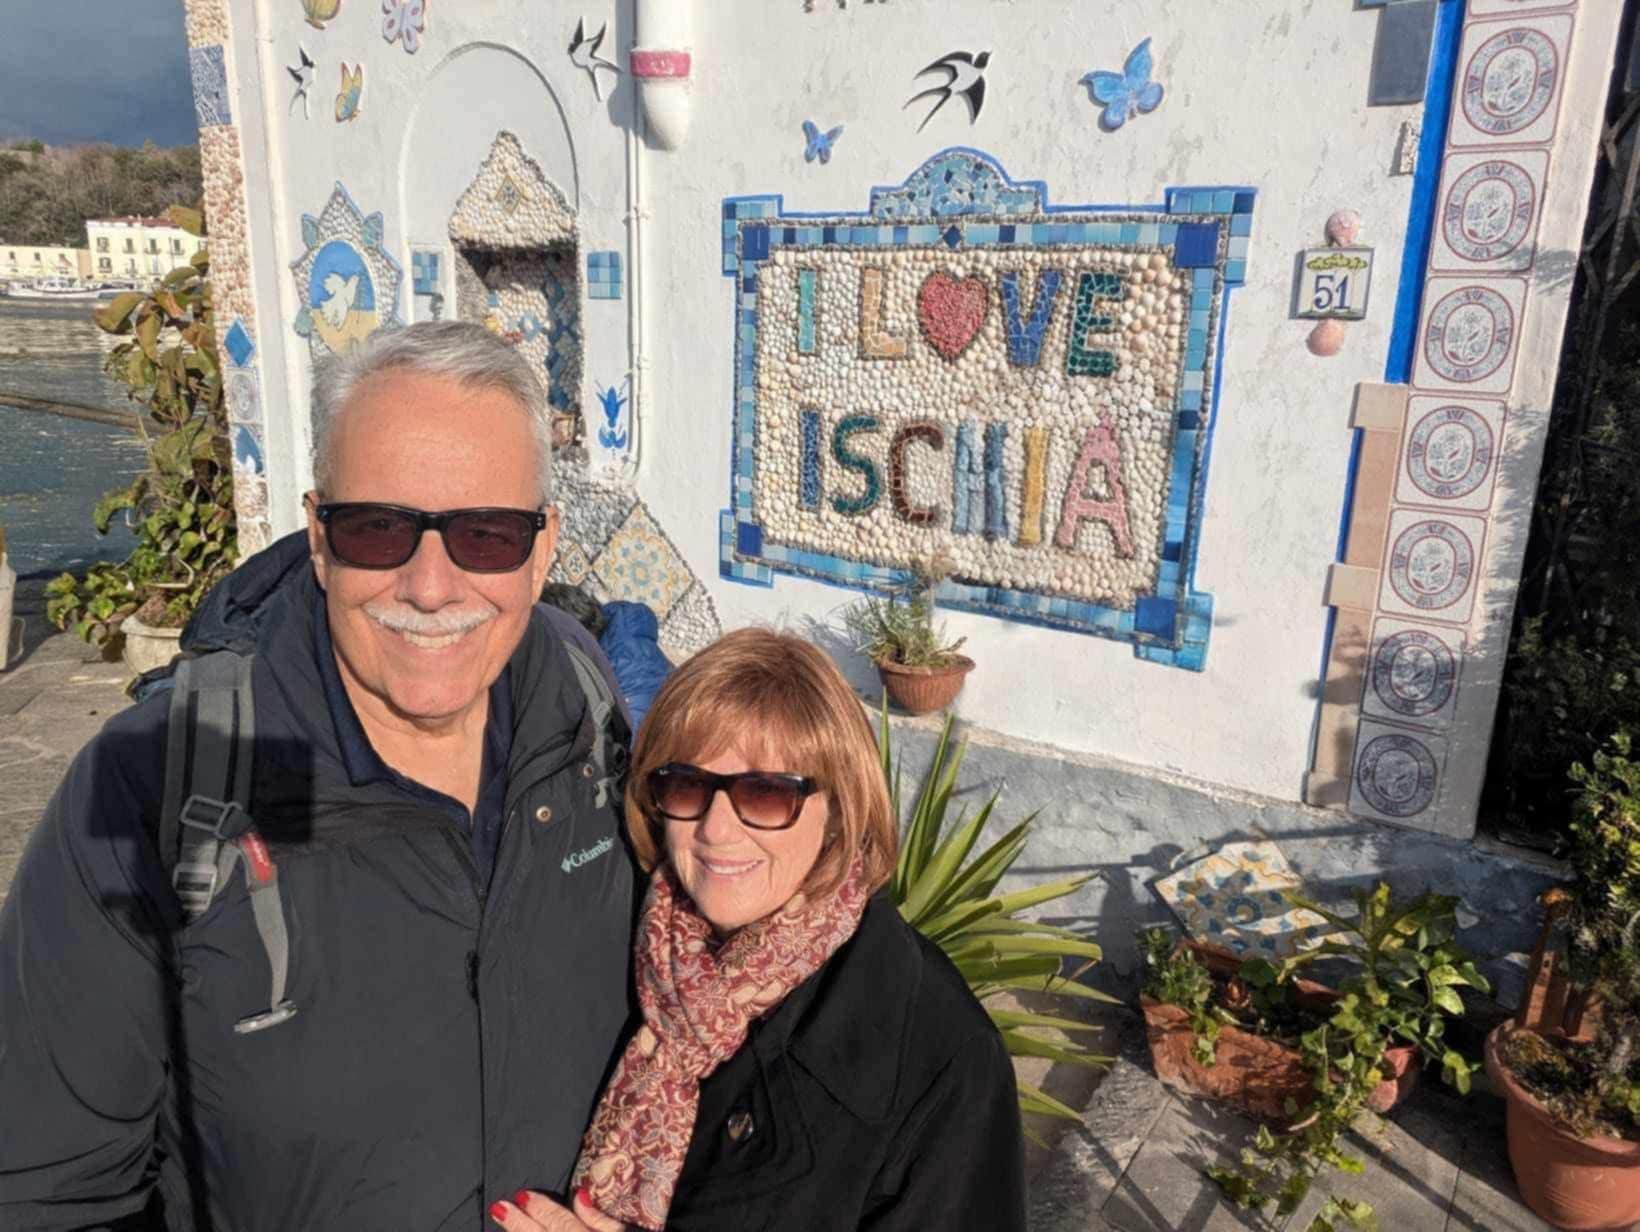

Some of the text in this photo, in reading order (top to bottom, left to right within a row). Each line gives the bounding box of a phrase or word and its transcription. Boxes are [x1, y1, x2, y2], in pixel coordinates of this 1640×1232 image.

[799, 268, 816, 355] I
[1313, 274, 1350, 310] 51
[800, 408, 1134, 559] ISCHIA
